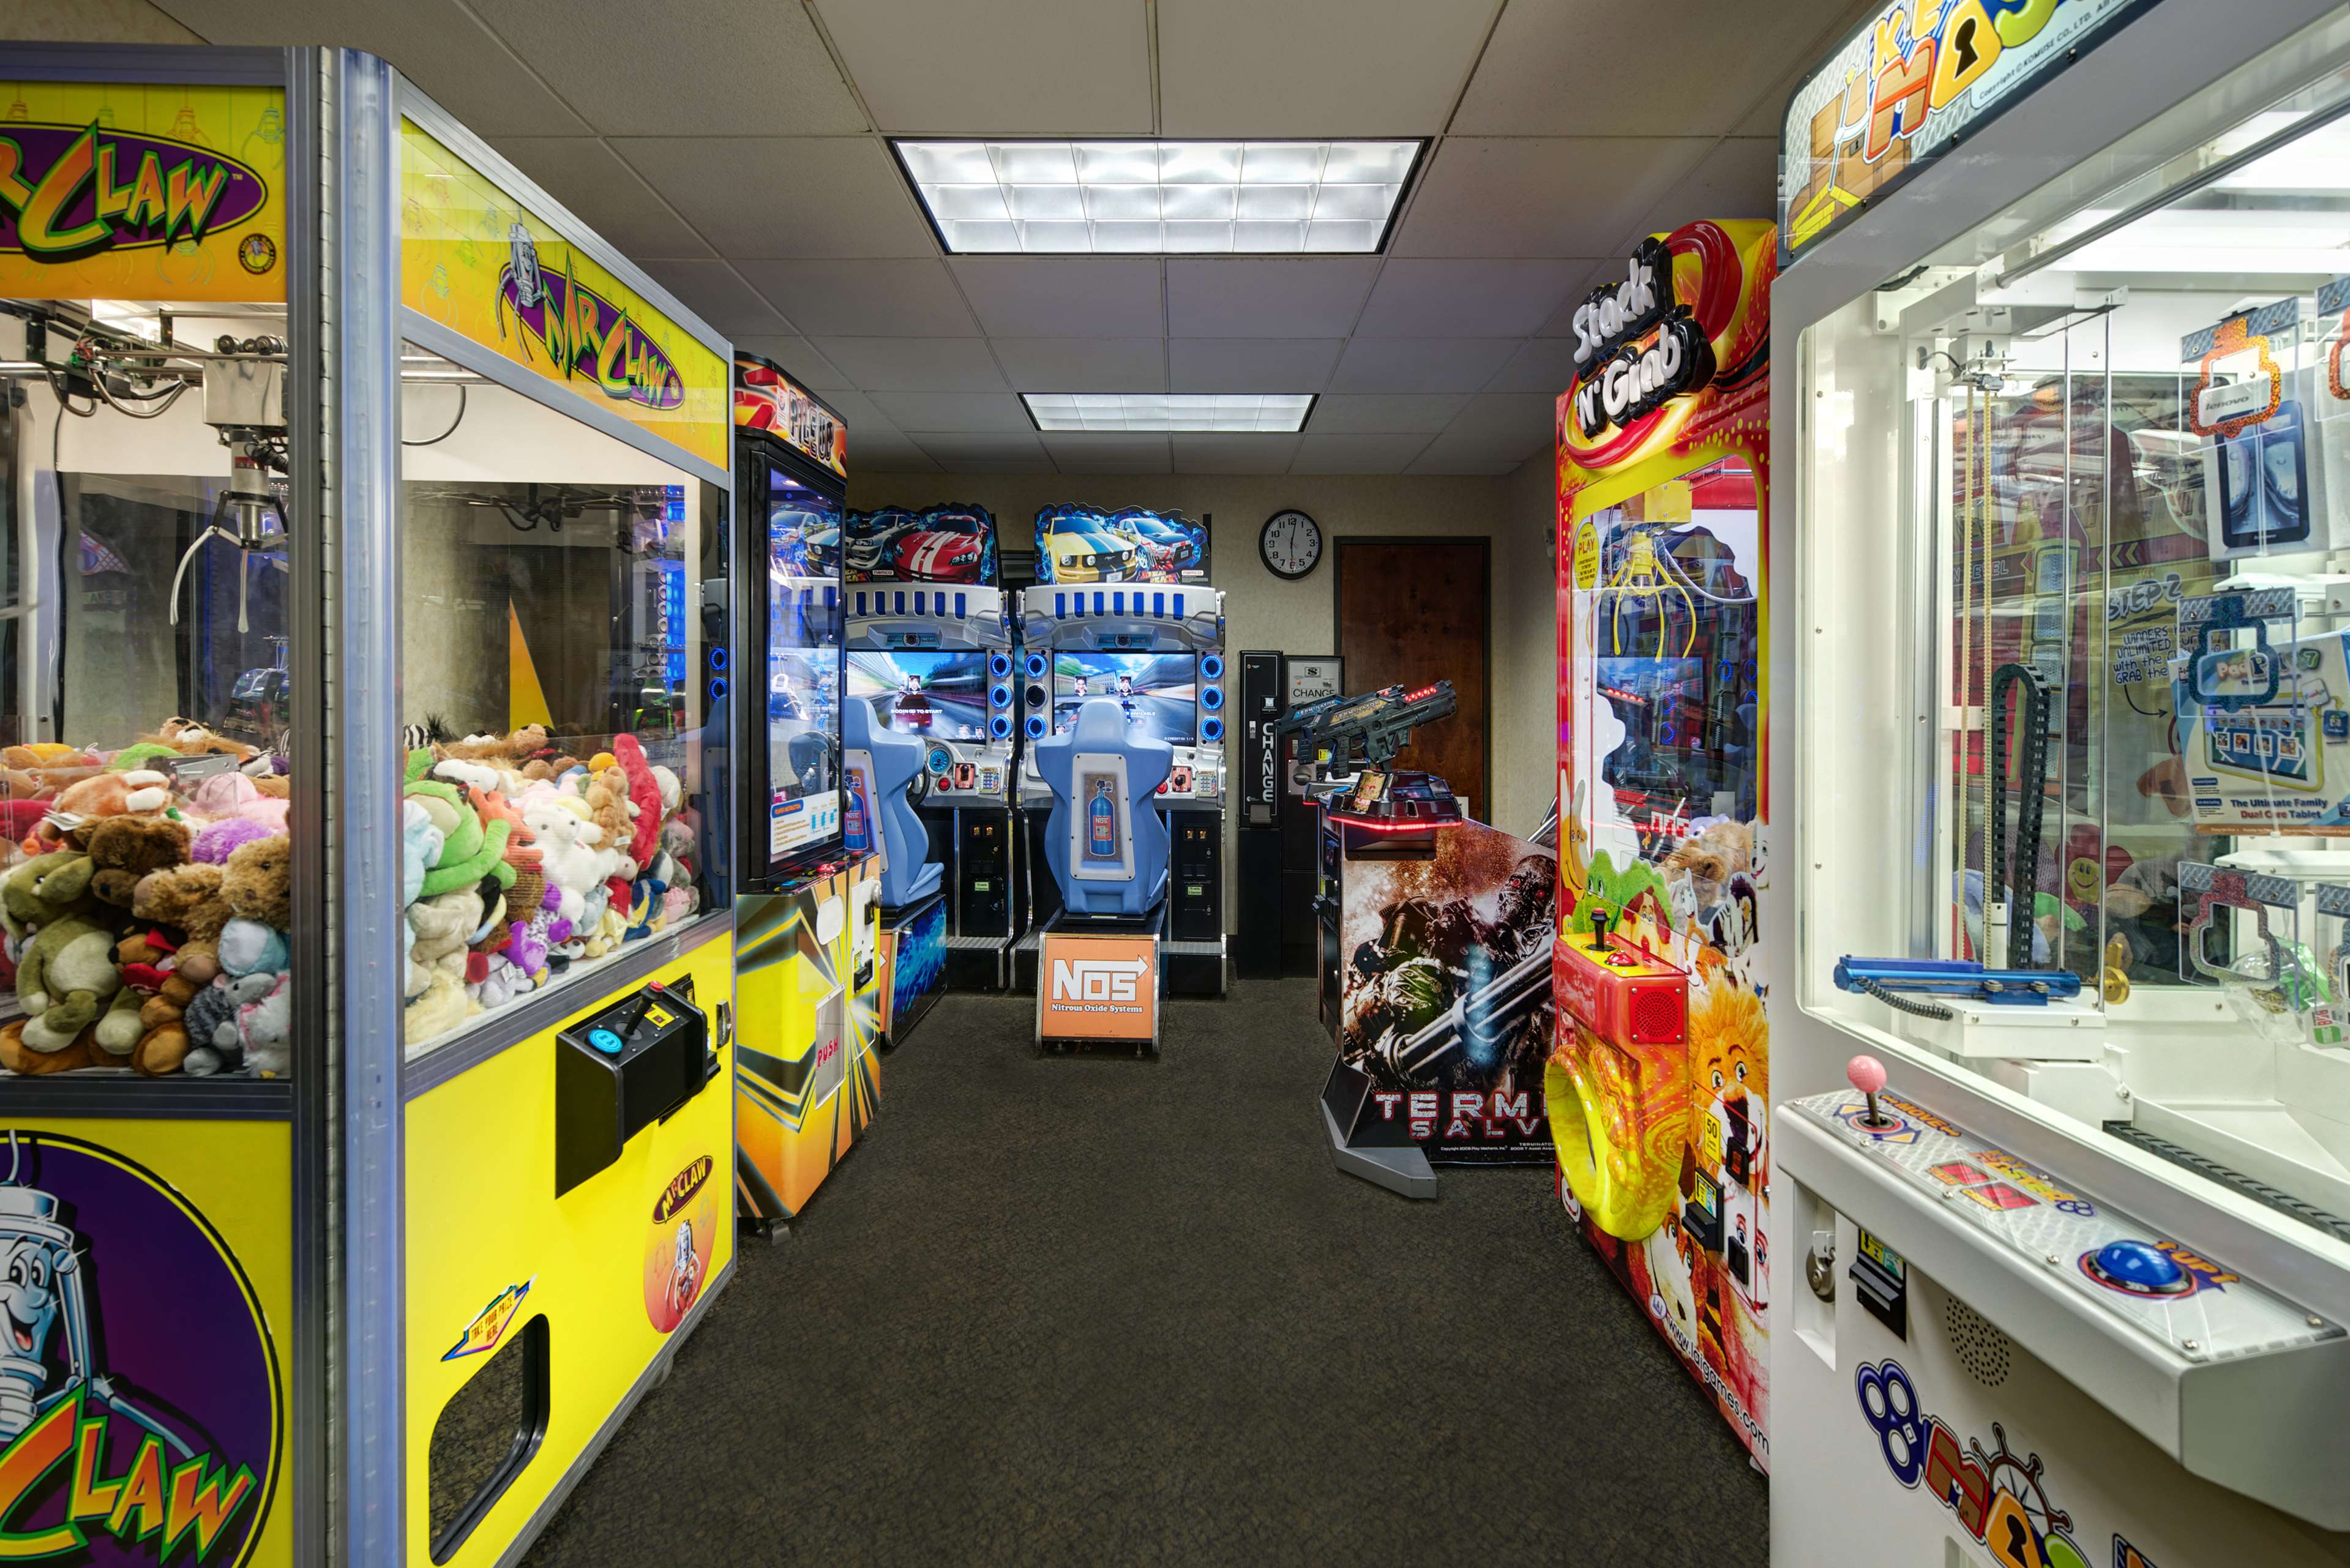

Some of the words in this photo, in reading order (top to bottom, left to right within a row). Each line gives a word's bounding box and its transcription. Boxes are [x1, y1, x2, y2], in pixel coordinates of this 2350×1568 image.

[1979, 69, 2016, 100] Copyright
[17, 119, 230, 252] CLAW
[542, 248, 604, 379] MR
[597, 307, 668, 405] CLAW
[1573, 258, 1655, 364] Stack
[1602, 323, 1682, 416] Grab
[2205, 396, 2250, 411] lenovo
[1288, 517, 1297, 526] 12
[1578, 537, 1595, 556] PLAY
[2109, 578, 2164, 621] STEP
[2113, 660, 2138, 672] with
[2142, 655, 2162, 667] the
[2115, 668, 2142, 685] GRAB
[2147, 667, 2168, 679] the
[1262, 722, 1274, 802] CHANGE
[2230, 799, 2247, 808] The
[2296, 799, 2328, 808] Family
[2240, 810, 2263, 819] Dual
[2289, 810, 2322, 819] Tablet
[1052, 955, 1149, 1001] NOS
[1051, 1003, 1083, 1012] Nitrous
[1084, 1004, 1108, 1012] Oxide
[1109, 1004, 1144, 1014] Systems
[817, 1036, 838, 1068] PUSH
[1707, 1118, 1717, 1138] 50
[1892, 1101, 1950, 1129] MOVE
[677, 1155, 706, 1200] CLAW
[2170, 1250, 2223, 1275] UP
[471, 1321, 484, 1342] TAKE
[485, 1309, 497, 1329] YOUR
[498, 1295, 513, 1316] PRIZE
[486, 1321, 498, 1343] HERE
[1666, 1314, 1770, 1456] www.laigames.com
[0, 1376, 258, 1567] CLAW
